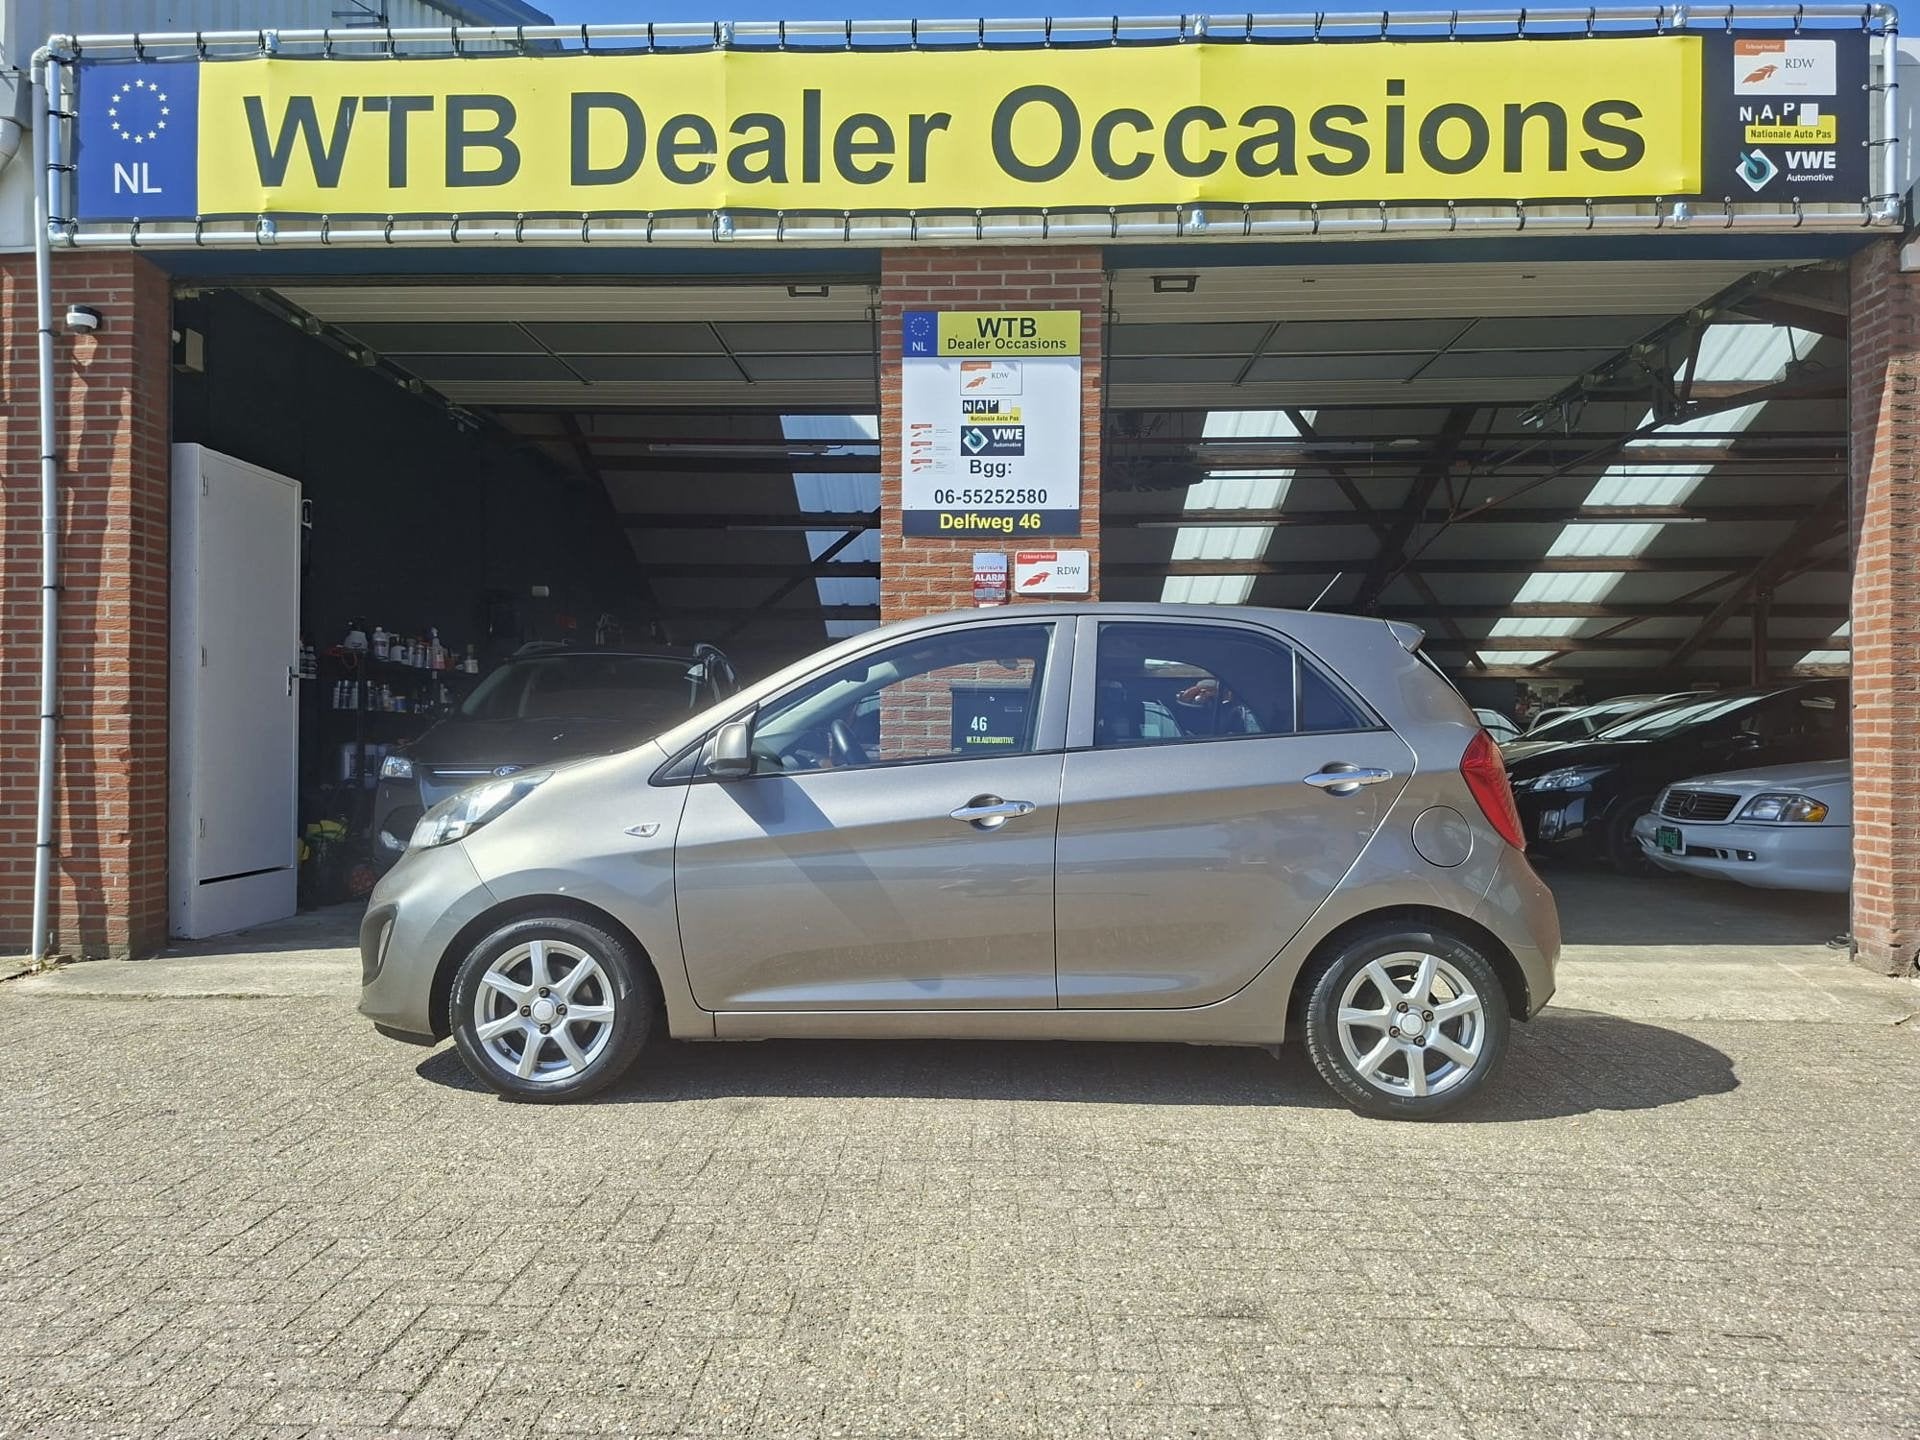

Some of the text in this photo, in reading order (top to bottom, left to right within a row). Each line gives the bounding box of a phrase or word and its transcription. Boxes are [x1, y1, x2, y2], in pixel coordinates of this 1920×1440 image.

[1785, 58, 1815, 69] RDW
[243, 78, 1646, 188] WTB Dealer Occasions
[1750, 129, 1832, 139] Nationale Auto Pas
[1785, 151, 1836, 169] VWE
[113, 163, 162, 194] NL
[1786, 174, 1834, 182] Automotive
[977, 317, 1037, 338] WTB
[912, 341, 927, 352] NL
[947, 337, 1067, 350] Dealer Occasions
[992, 428, 1023, 441] VWE
[969, 459, 1012, 478] Bgg:
[934, 489, 1048, 504] 06-55252580
[940, 513, 1041, 533] Delfweg 46
[974, 573, 1006, 582] ALARM
[1057, 566, 1081, 576] RDW
[971, 716, 988, 731] 46
